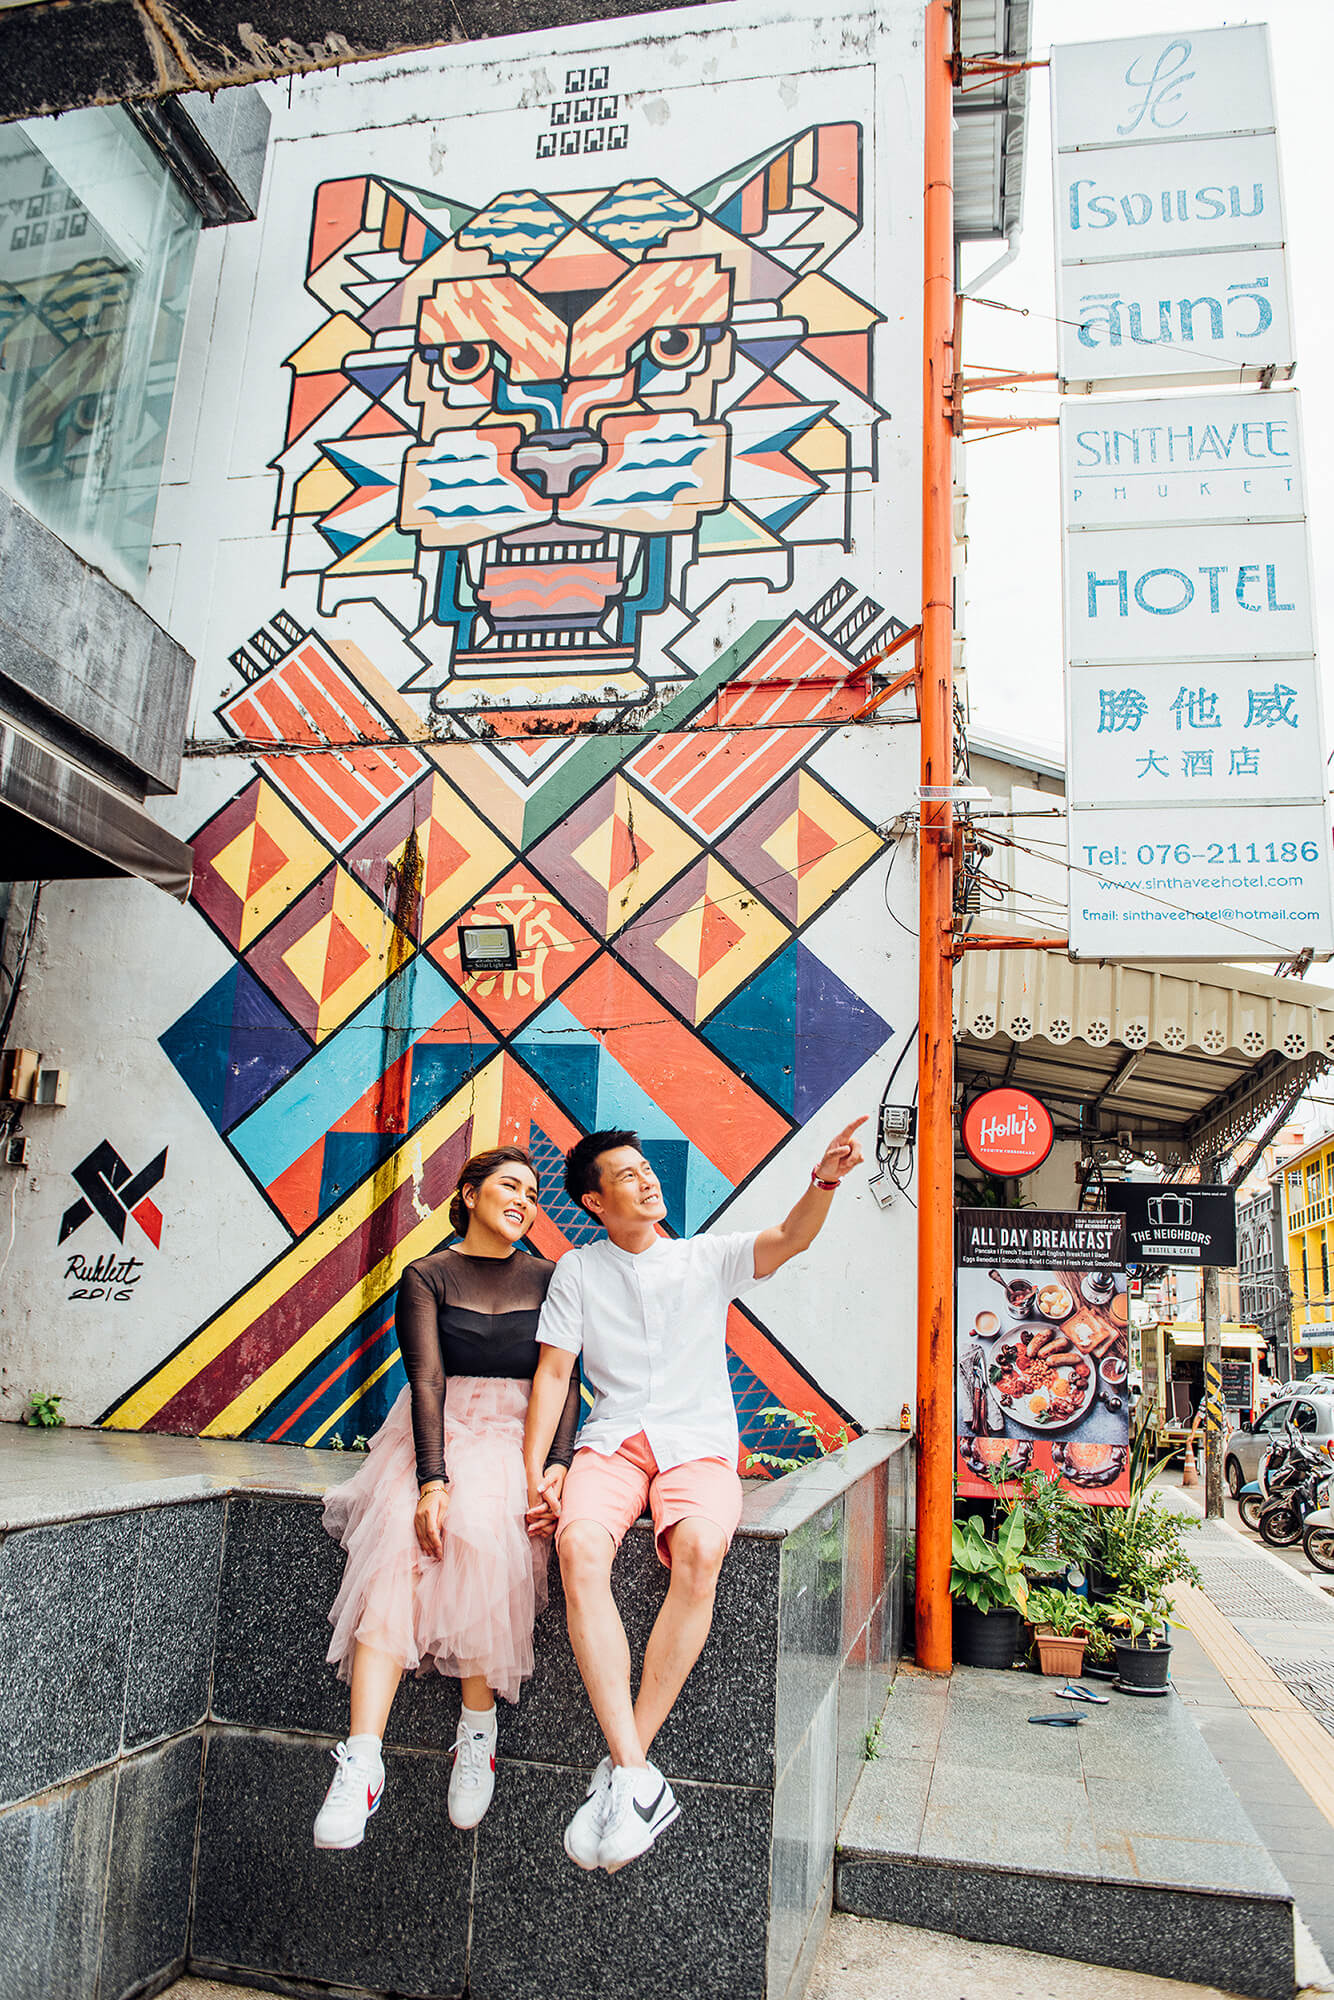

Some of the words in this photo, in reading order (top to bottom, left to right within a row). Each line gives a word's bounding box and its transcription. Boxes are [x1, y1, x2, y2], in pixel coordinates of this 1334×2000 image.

[1068, 179, 1264, 230] โรงแรม
[1077, 277, 1273, 348] สินทวี
[1076, 421, 1290, 467] SINTHAVEE
[1074, 478, 1293, 501] PHUKET
[1087, 564, 1295, 618] HOTEL
[1097, 683, 1299, 733] 勝他威
[1135, 746, 1260, 778] 大酒店
[1082, 845, 1127, 866] Tel:
[1137, 841, 1319, 866] 076-211186
[1098, 874, 1303, 890] www.sinthaveehotel.com
[1082, 908, 1118, 921] Email:
[1122, 907, 1320, 921] sinthaveehotel@hotmail.com
[980, 1111, 1037, 1146] Holly's
[971, 1226, 996, 1246] ALL
[1000, 1228, 1028, 1247] DAY
[1032, 1228, 1113, 1250] BREAKFAST
[1131, 1229, 1152, 1243] THE
[1153, 1228, 1212, 1245] NEIGHBORS
